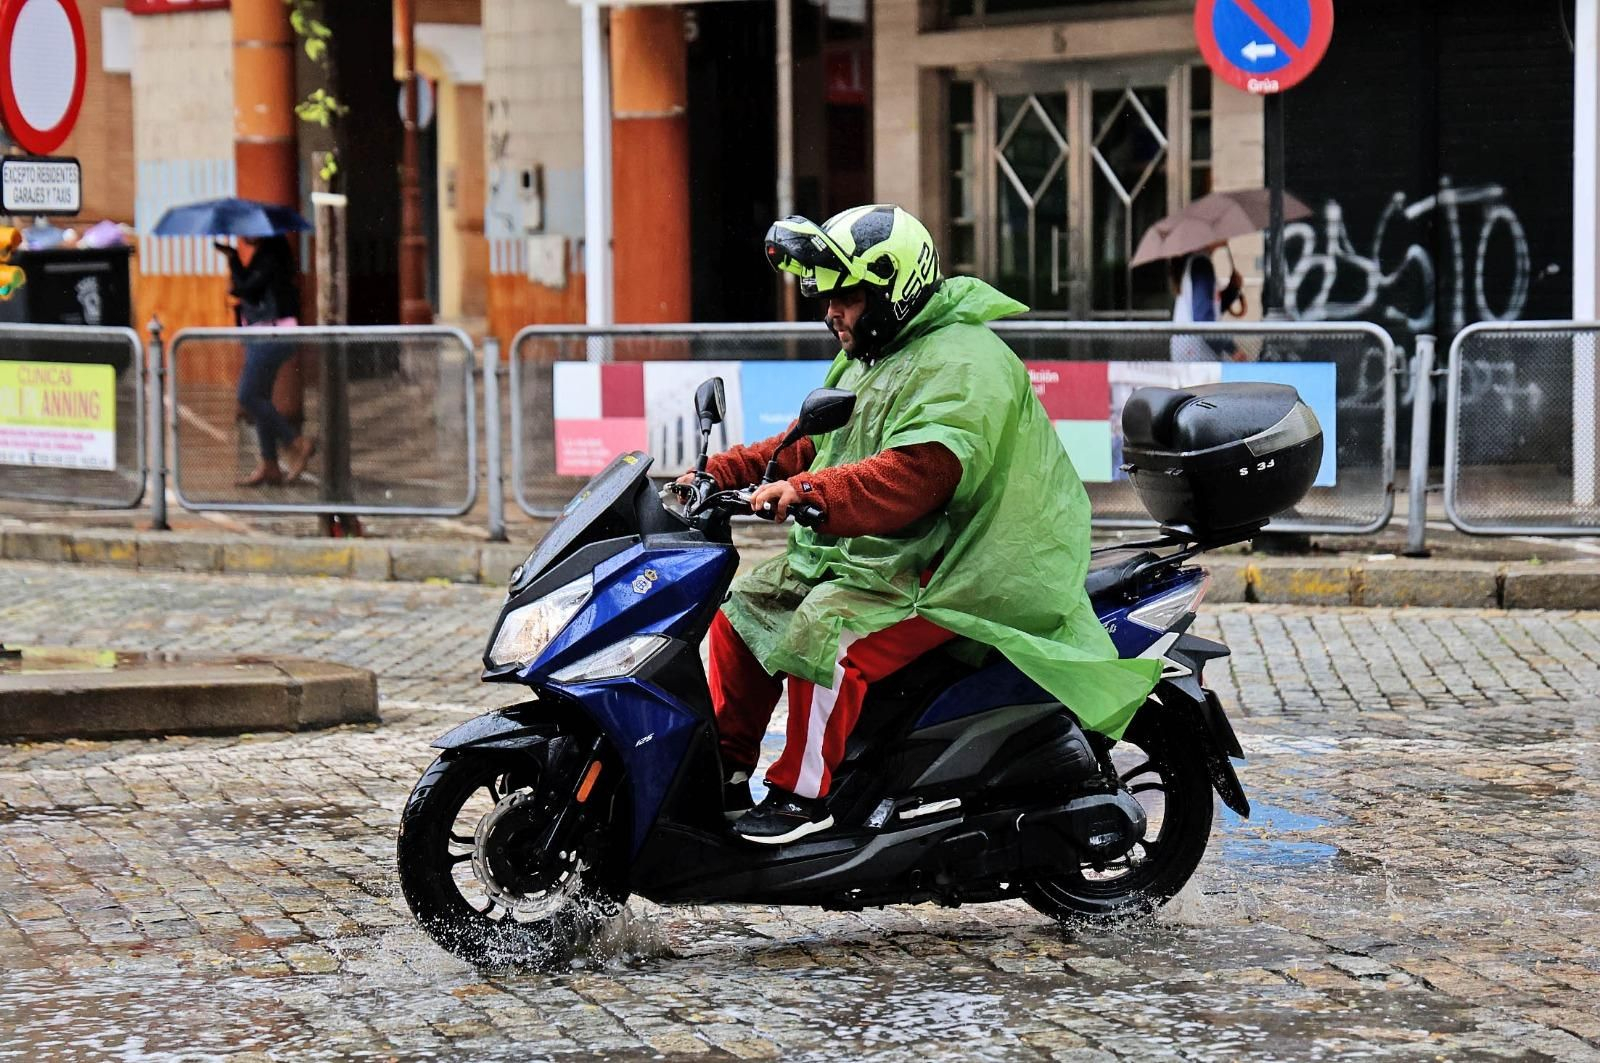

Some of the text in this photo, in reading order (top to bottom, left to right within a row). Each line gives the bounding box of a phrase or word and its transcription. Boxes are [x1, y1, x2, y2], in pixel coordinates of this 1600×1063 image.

[1248, 78, 1279, 94] Grúa
[4, 166, 77, 184] EXCEPTO RESIDENTES
[13, 186, 45, 204] GARAJES
[52, 186, 72, 204] TAXIS
